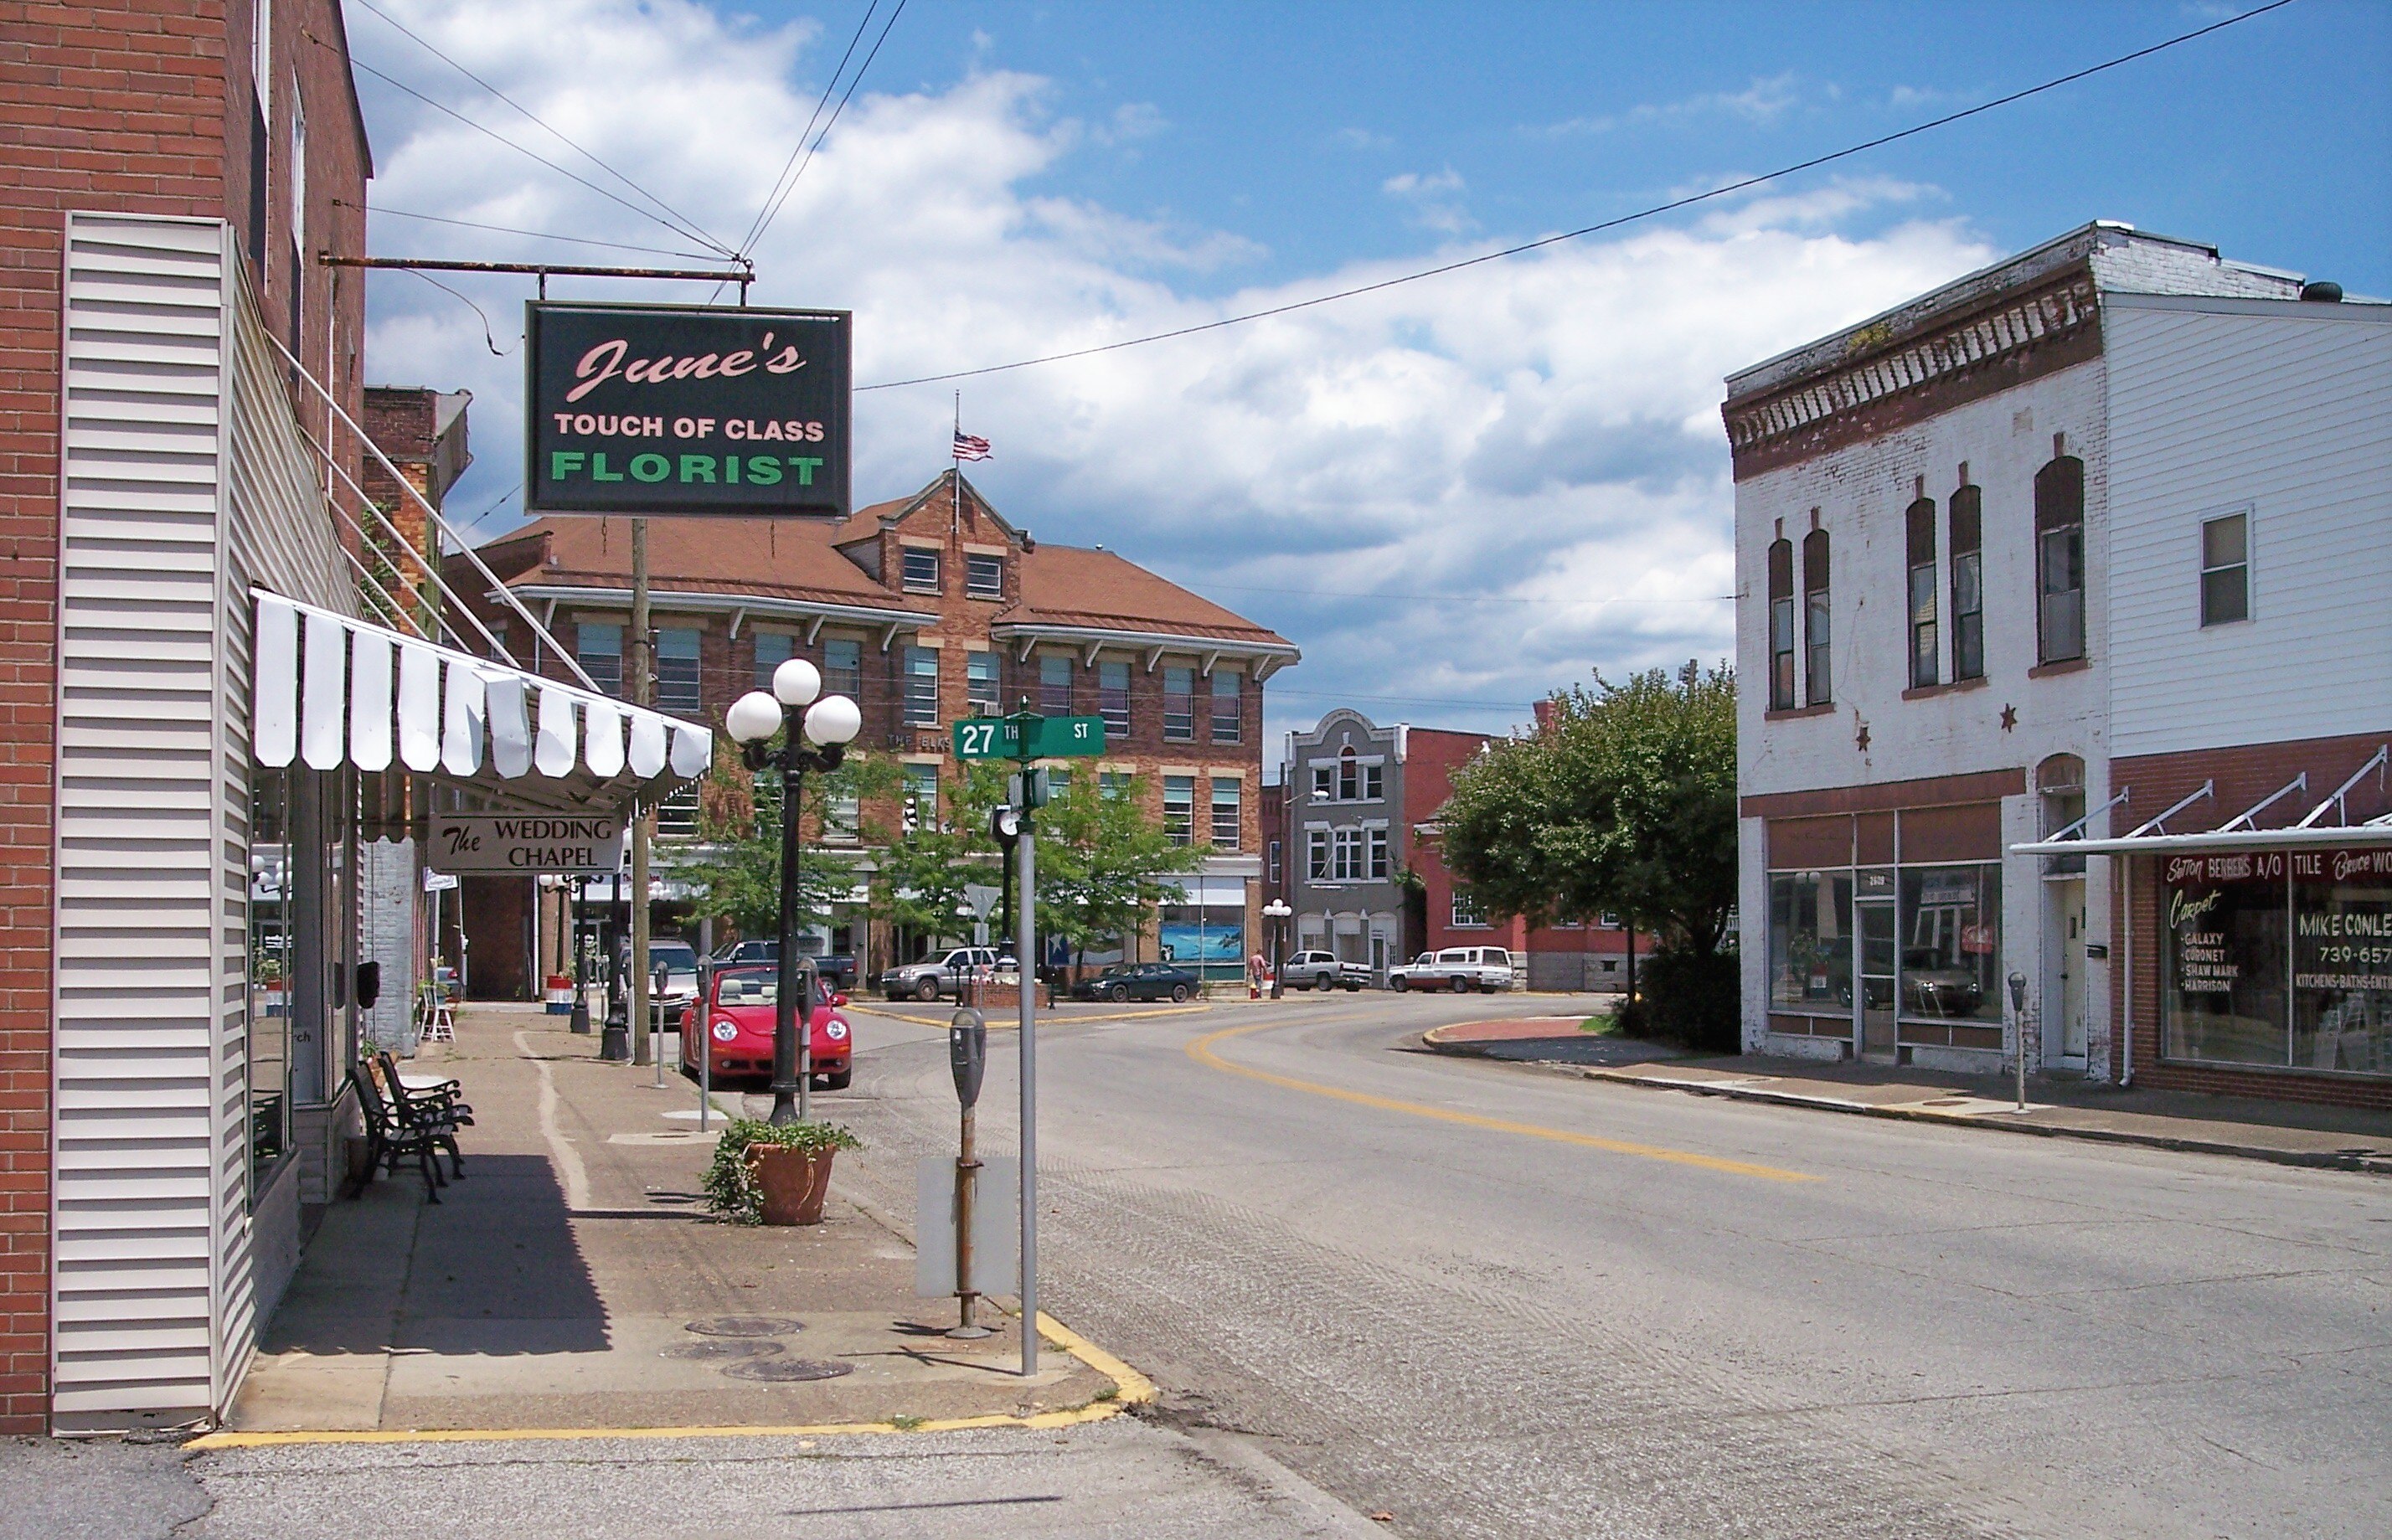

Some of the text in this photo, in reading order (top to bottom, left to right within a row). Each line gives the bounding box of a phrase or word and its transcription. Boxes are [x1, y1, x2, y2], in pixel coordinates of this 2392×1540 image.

[565, 332, 807, 403] June's
[554, 414, 824, 442] TOUCH OF CLASS
[552, 451, 823, 487] FLORIST
[921, 736, 951, 748] ELKS
[962, 723, 1088, 754] 27 TH ST
[442, 820, 611, 855] The WEDDING
[508, 847, 598, 867] CHAPEL
[2295, 854, 2322, 875] TILE
[2170, 888, 2222, 930] Carpet
[2299, 913, 2341, 936] MIKE
[2184, 932, 2224, 945] GALAXY
[2184, 947, 2224, 962] CORONET
[2185, 965, 2211, 976] SHAW
[2184, 979, 2230, 991] HARRISON
